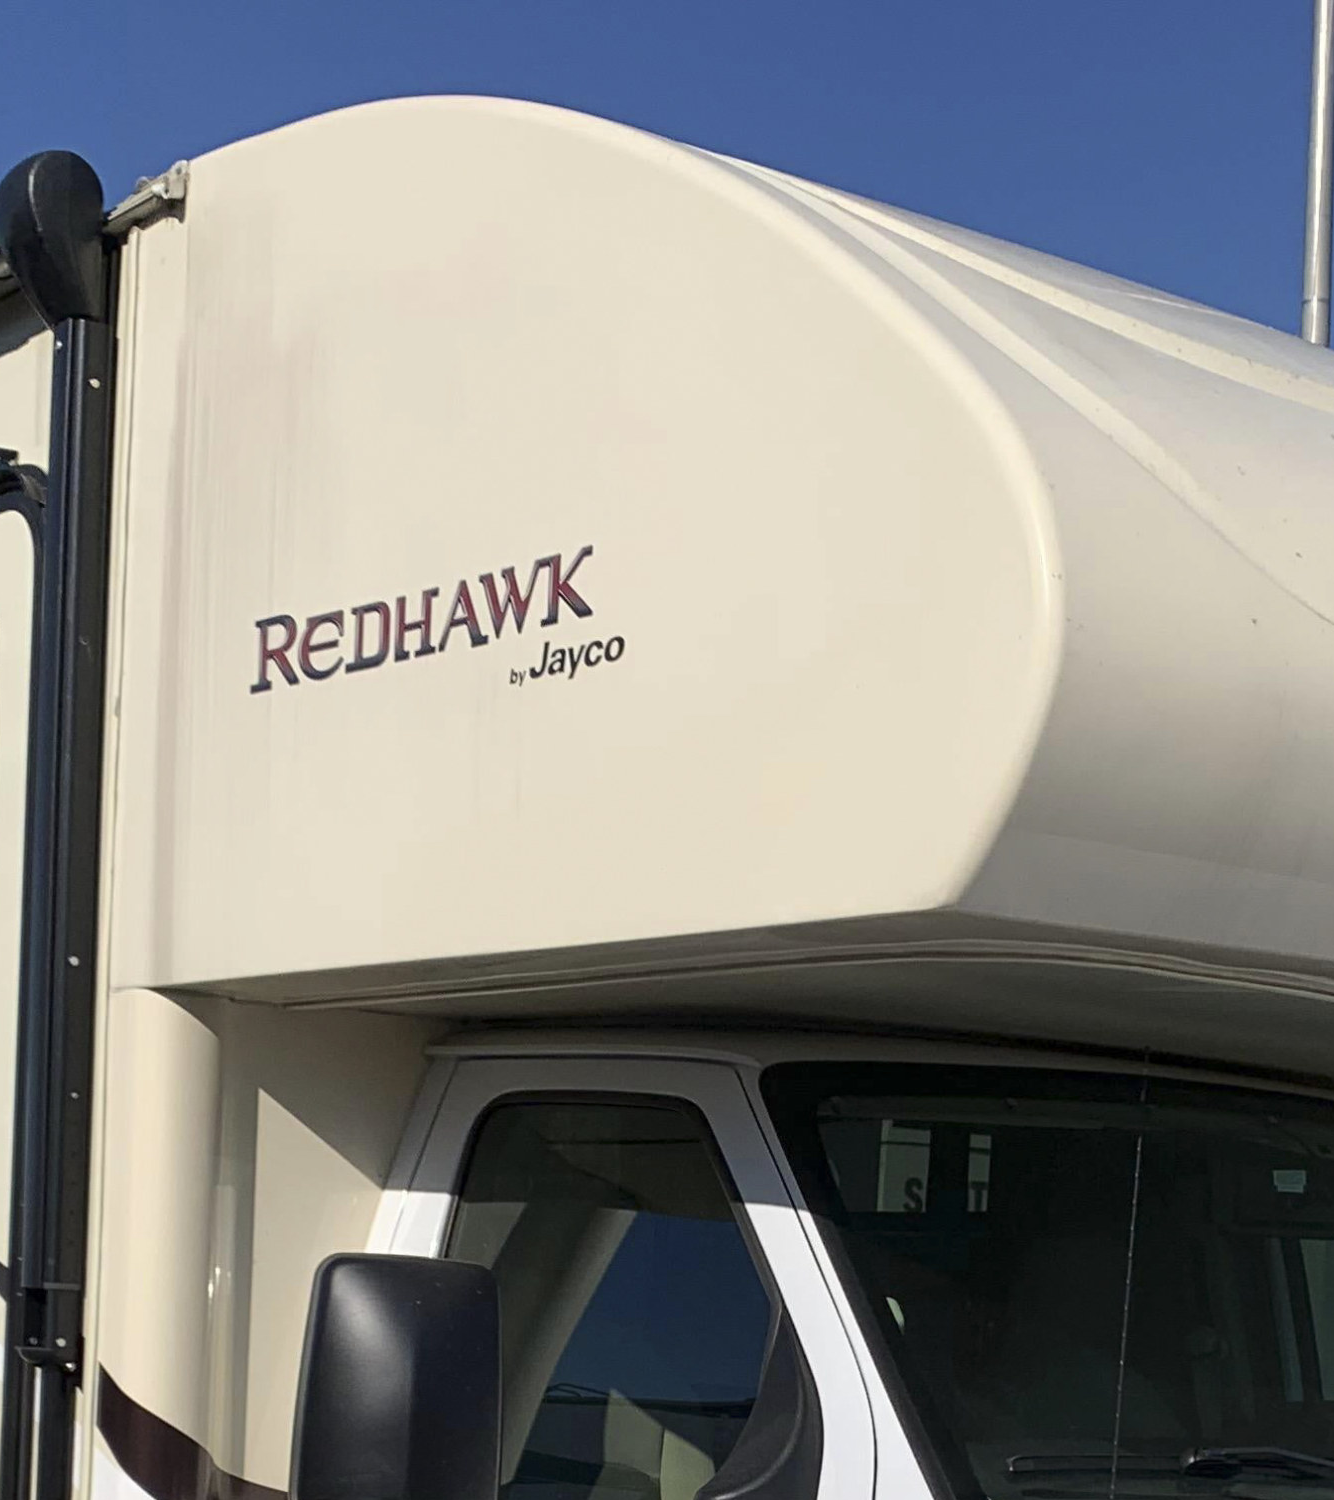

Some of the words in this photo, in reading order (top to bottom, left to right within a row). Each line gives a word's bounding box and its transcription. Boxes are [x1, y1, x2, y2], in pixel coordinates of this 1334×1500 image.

[249, 544, 594, 695] REDHAWK
[509, 668, 527, 687] by
[529, 635, 625, 681] Jayco
